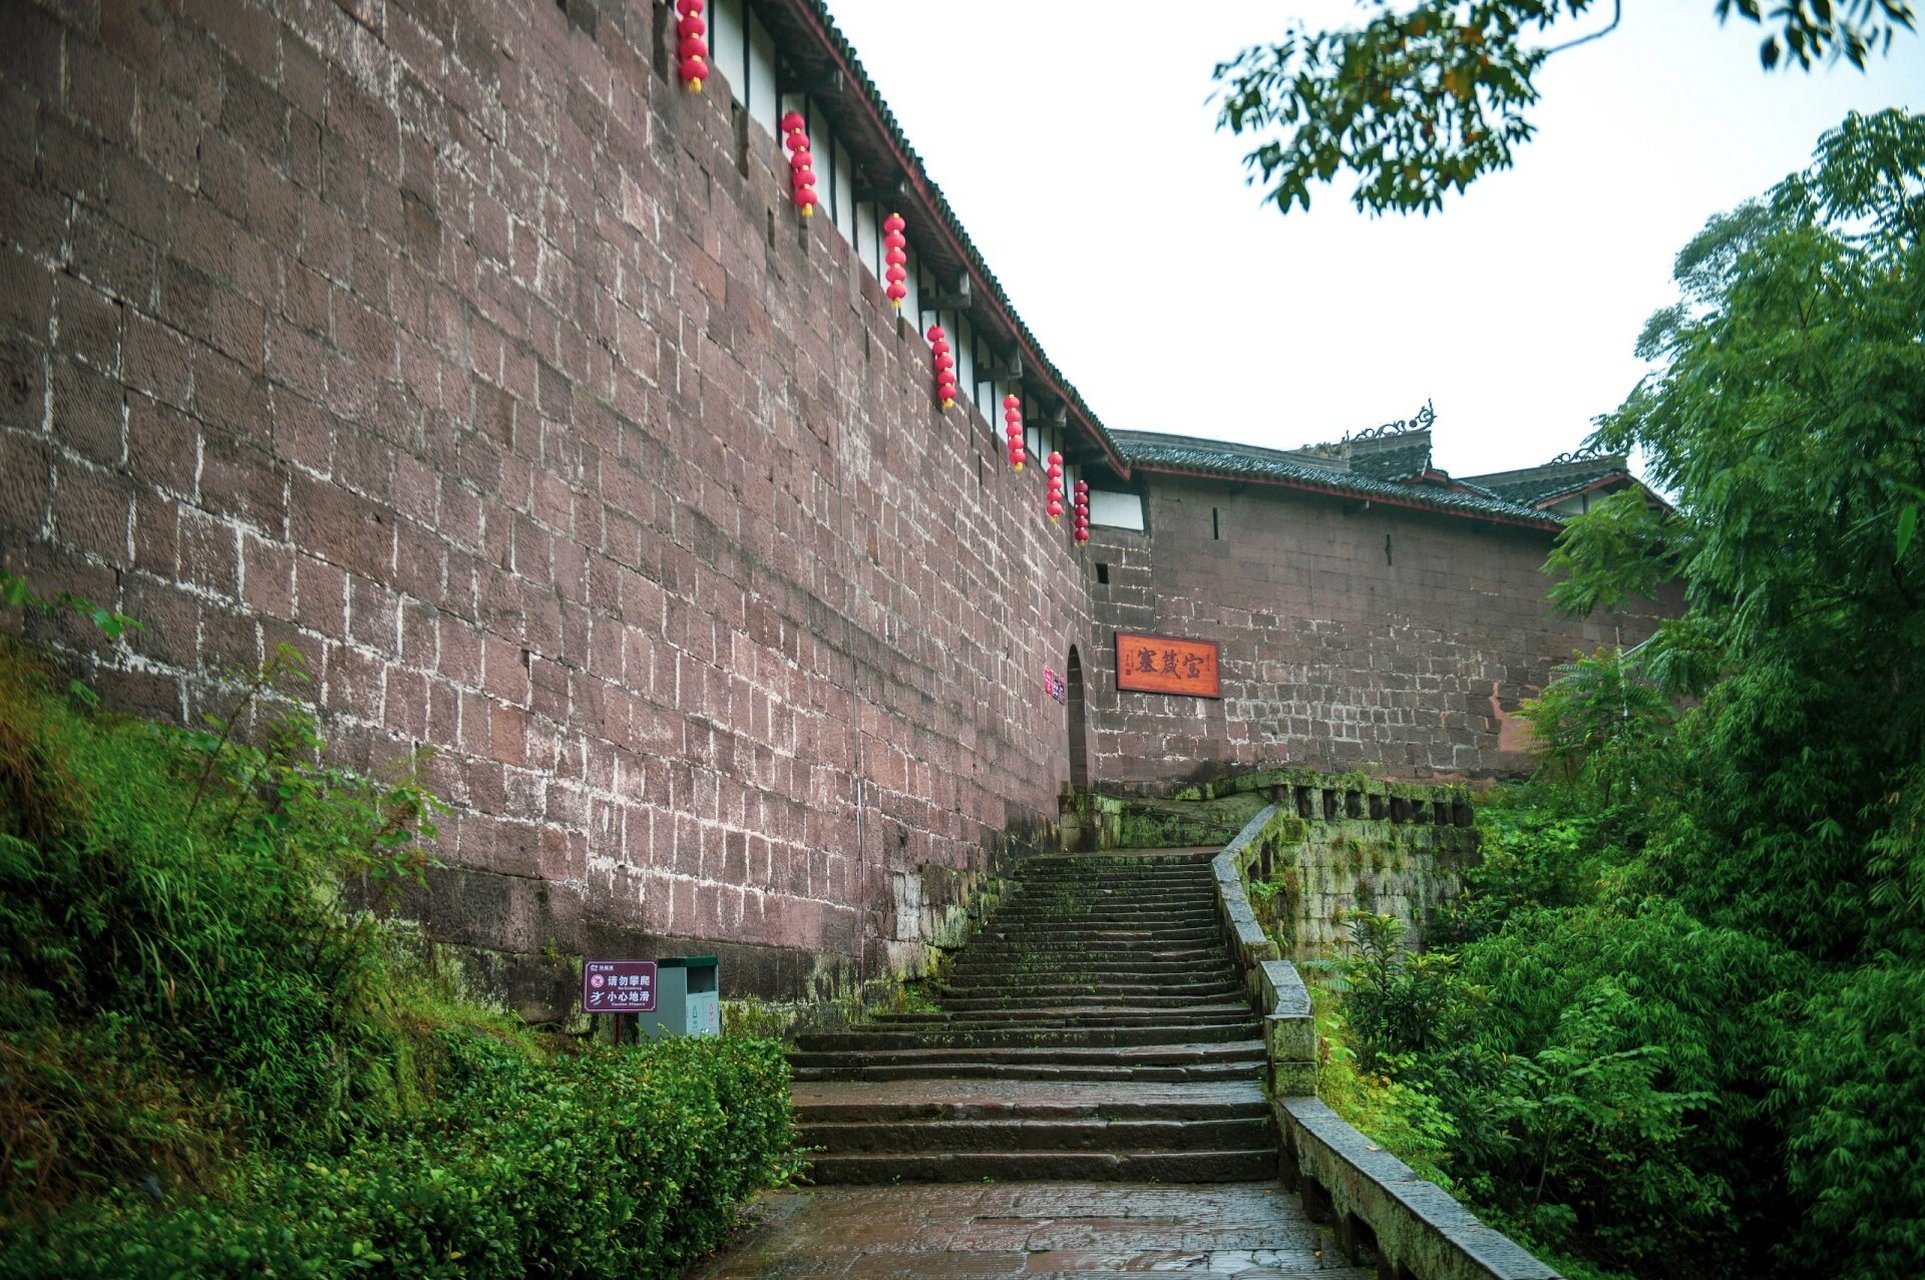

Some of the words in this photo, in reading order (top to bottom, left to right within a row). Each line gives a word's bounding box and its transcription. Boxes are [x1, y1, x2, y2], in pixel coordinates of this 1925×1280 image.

[607, 975, 650, 986] 请勿攀爬
[607, 991, 650, 1002] 小心地滑
